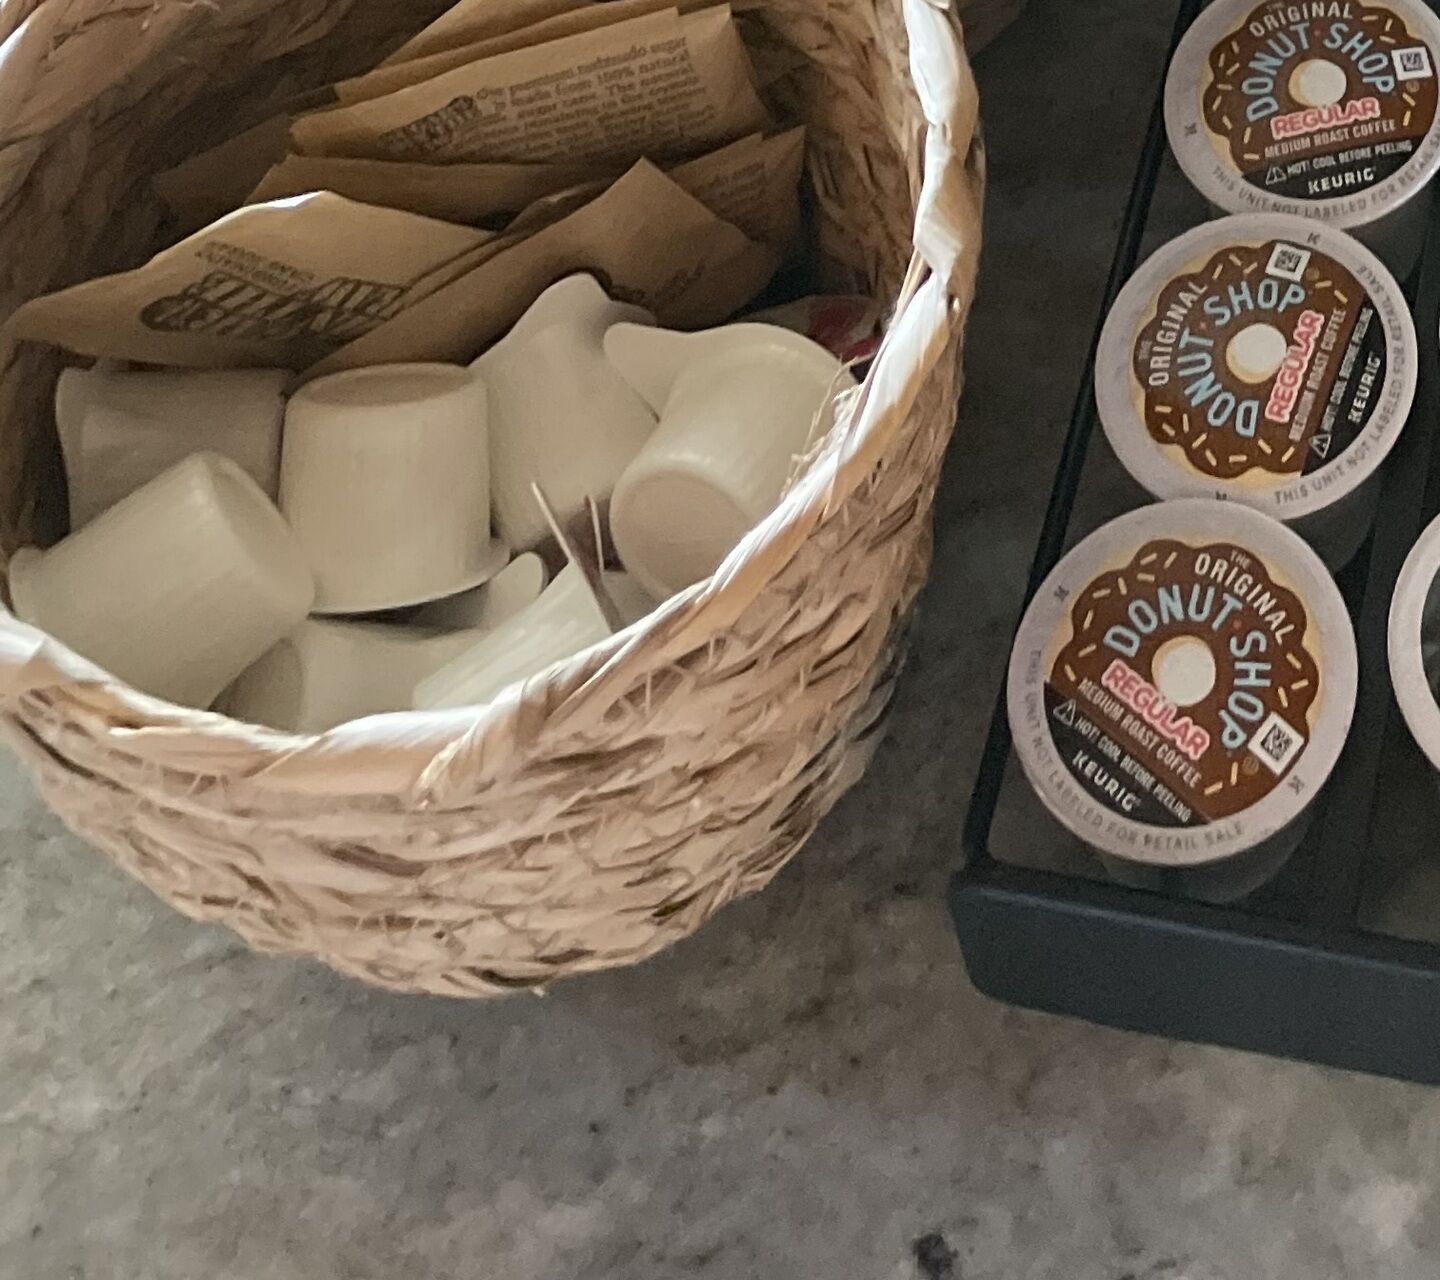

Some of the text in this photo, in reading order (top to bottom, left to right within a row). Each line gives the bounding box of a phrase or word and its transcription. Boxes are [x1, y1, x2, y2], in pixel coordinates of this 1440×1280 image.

[1248, 0, 1355, 38] ORIGINAL
[1240, 21, 1396, 123] DONUT SHOP
[1270, 96, 1381, 140] REGULAR
[1263, 135, 1312, 159] MEDIUM
[1352, 118, 1397, 139] COFFEE
[1307, 167, 1375, 195] KEURIG
[1148, 280, 1209, 388] ORIGINAL
[1176, 278, 1307, 438] DONUT SHOP
[1265, 309, 1326, 424] REGULAR
[1347, 351, 1382, 425] KEURIG
[1194, 552, 1297, 646] ORIGINAL
[1101, 659, 1210, 762] REGULAR
[1102, 583, 1273, 750] DONUT SHOP
[1071, 748, 1139, 813] KEURIG
[1076, 676, 1203, 790] MEDIUM ROAST COFFEE
